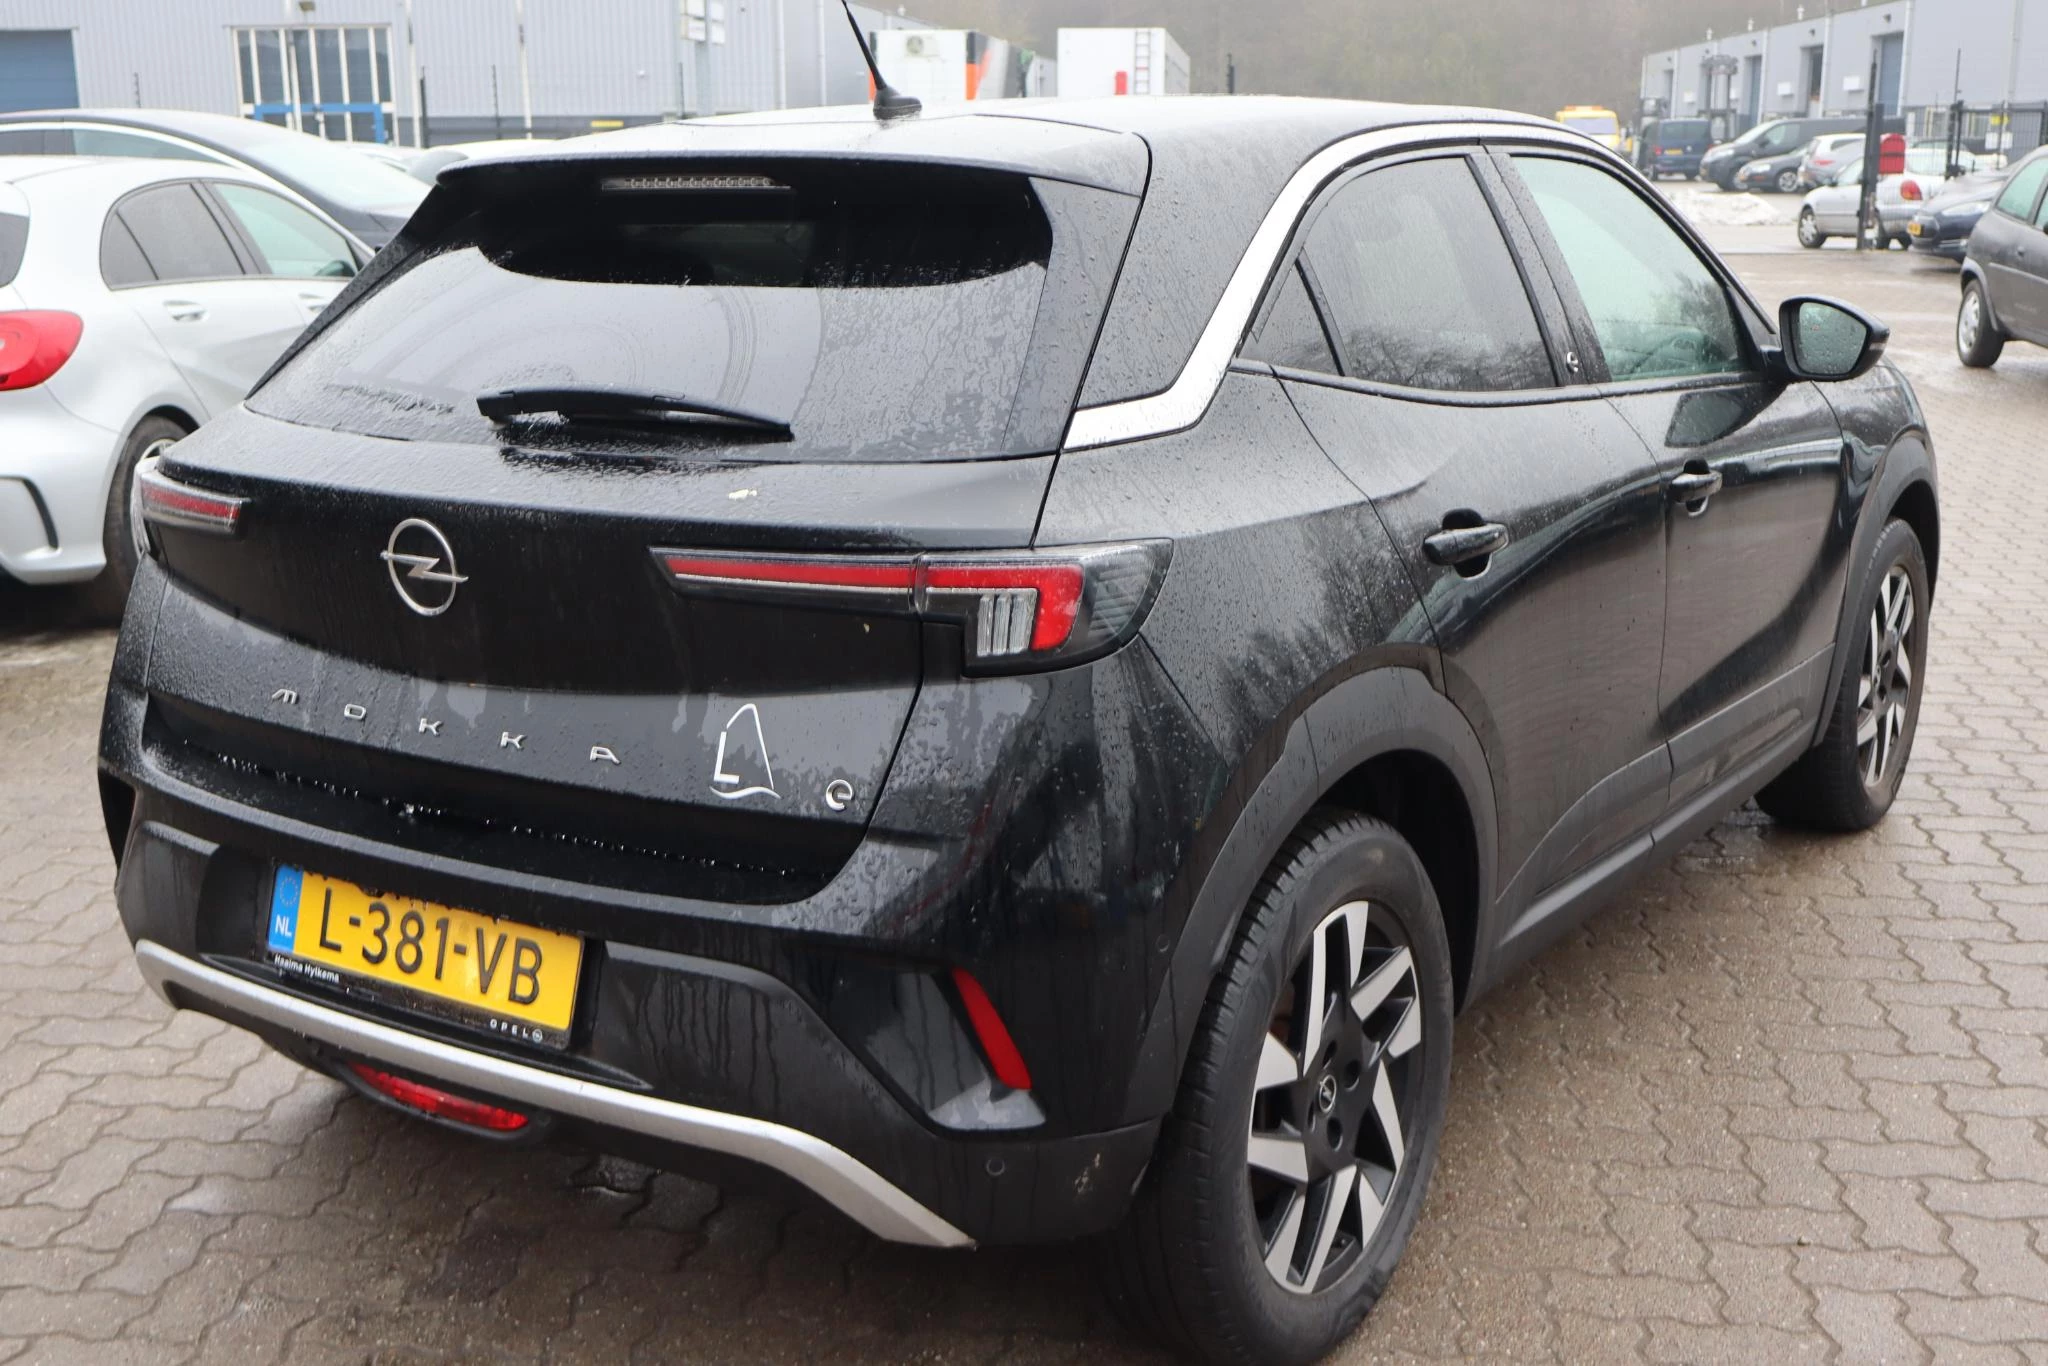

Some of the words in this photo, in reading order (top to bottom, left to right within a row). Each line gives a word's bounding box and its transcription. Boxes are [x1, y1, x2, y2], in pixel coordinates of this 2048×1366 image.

[272, 689, 621, 765] MOKKA
[275, 914, 292, 937] NL
[319, 887, 543, 1005] L-381-VB
[489, 1018, 529, 1040] OPEL
